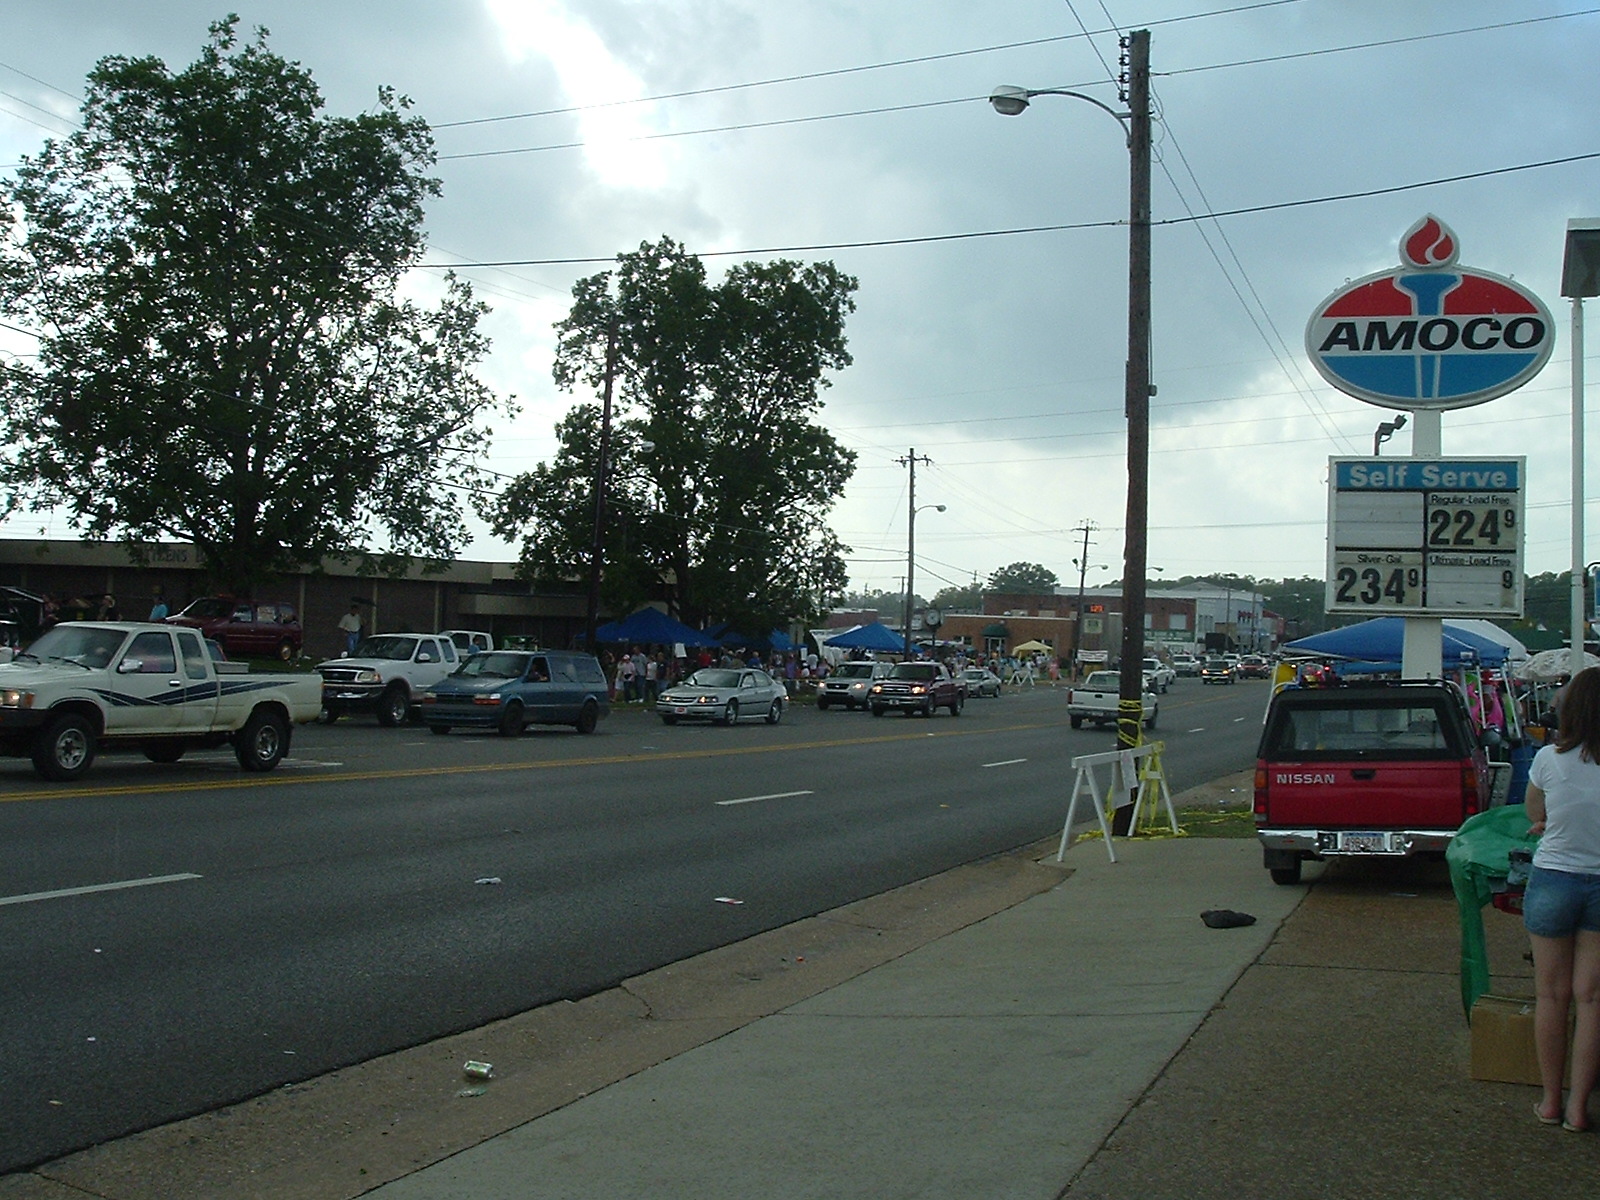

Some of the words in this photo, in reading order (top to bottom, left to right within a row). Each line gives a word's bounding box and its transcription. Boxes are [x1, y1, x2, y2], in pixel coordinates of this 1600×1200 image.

[1318, 317, 1546, 352] AMOCO
[1350, 464, 1408, 487] Self
[1421, 464, 1508, 488] Serve
[1502, 569, 1513, 589] 9
[1276, 773, 1335, 784] NISSAN
